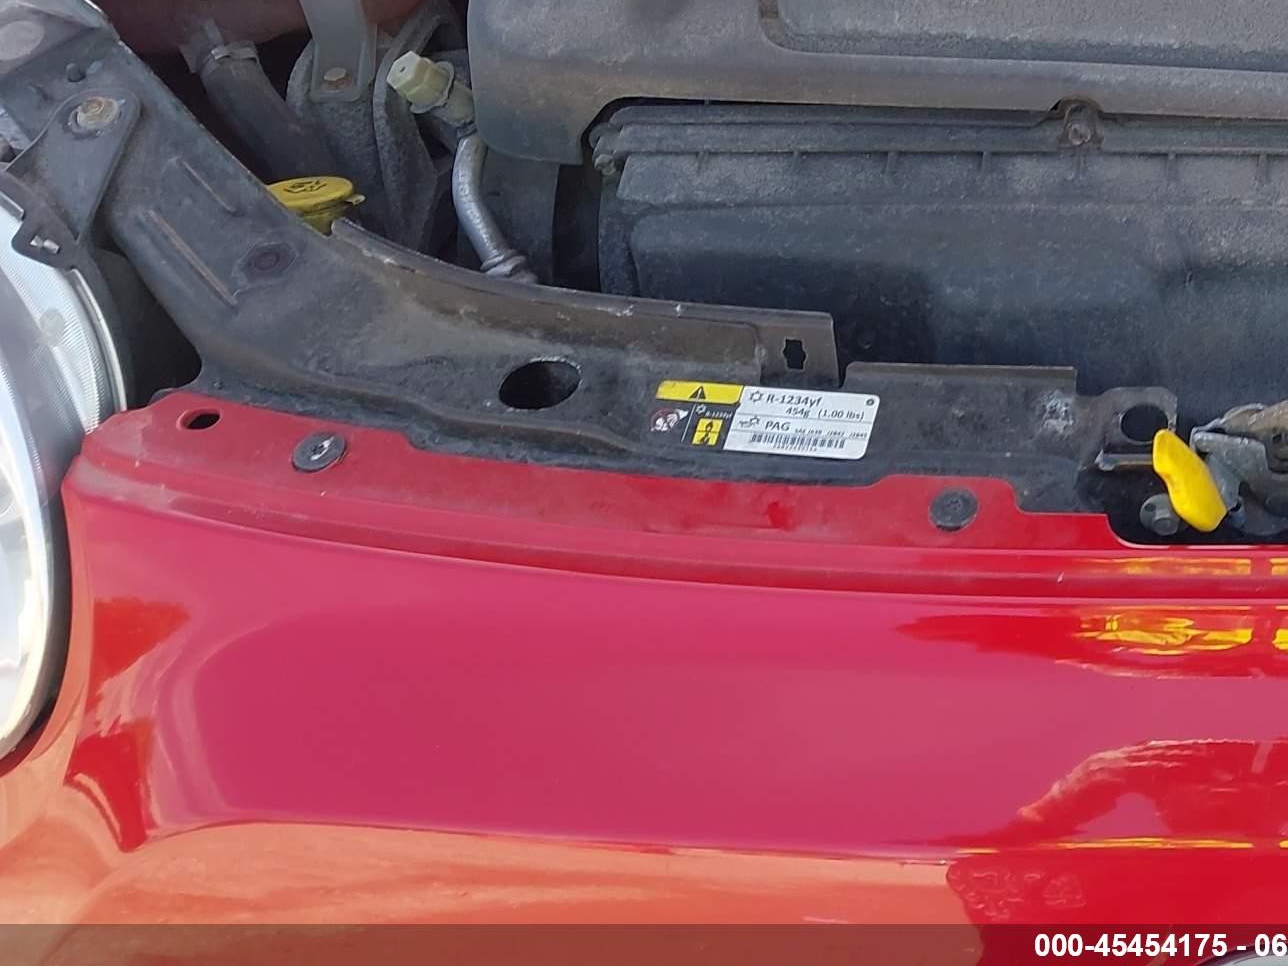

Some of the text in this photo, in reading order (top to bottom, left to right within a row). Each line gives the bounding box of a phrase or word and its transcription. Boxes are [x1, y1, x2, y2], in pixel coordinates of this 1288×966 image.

[764, 394, 823, 410] R-1234yf
[785, 407, 866, 422] 454g (1.00 lbs)
[764, 420, 791, 432] PAG
